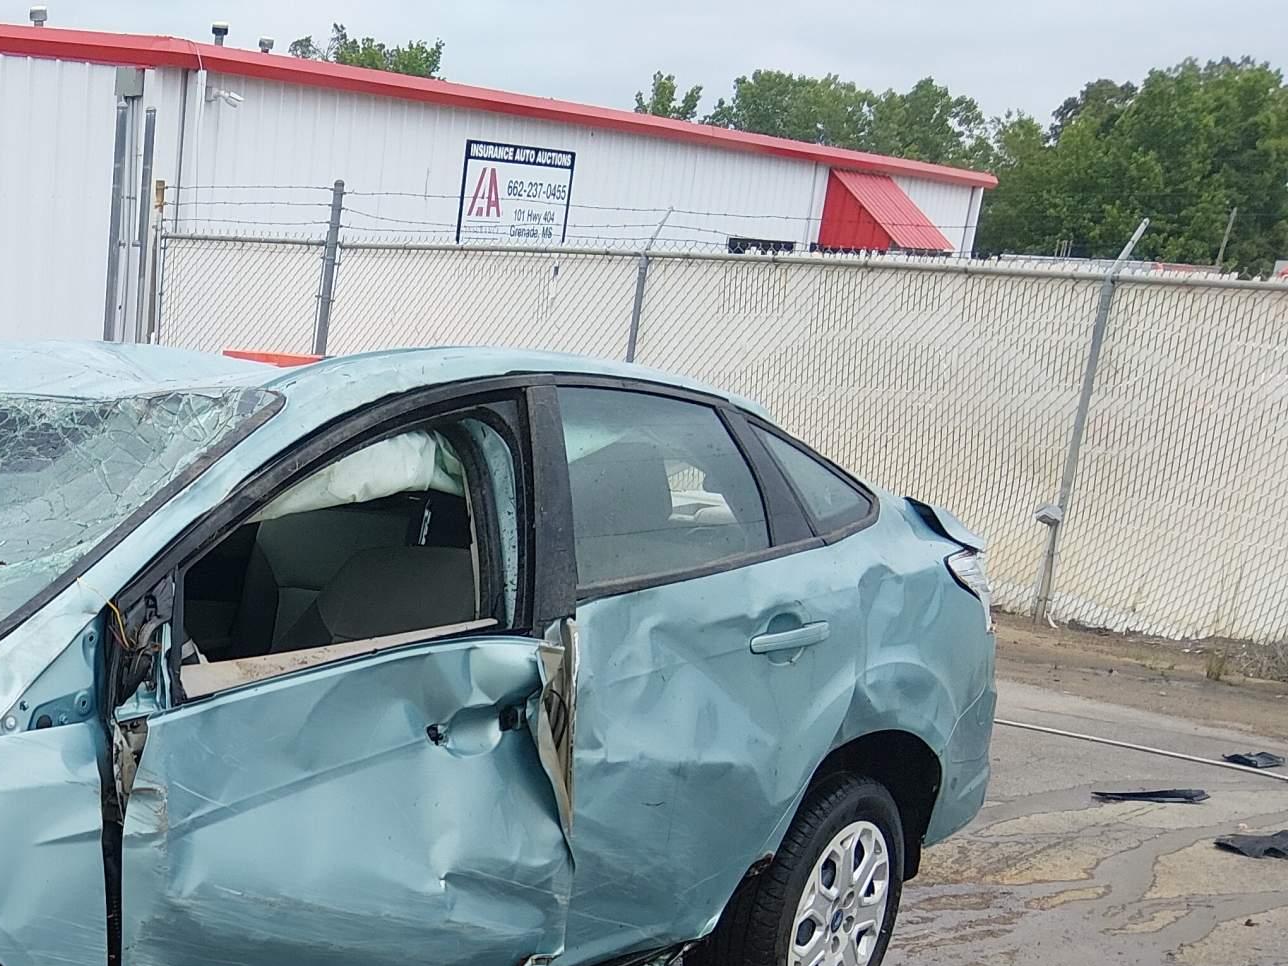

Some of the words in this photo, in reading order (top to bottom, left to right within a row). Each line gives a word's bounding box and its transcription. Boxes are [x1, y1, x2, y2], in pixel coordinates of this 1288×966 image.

[470, 143, 515, 161] INSURANCE
[514, 147, 536, 163] AUTO
[536, 150, 572, 167] AUCTIONS
[507, 180, 567, 201] 662-237-0455
[514, 209, 525, 222] 101
[526, 209, 542, 224] Hwy
[543, 210, 555, 223] 404
[541, 226, 553, 239] MS
